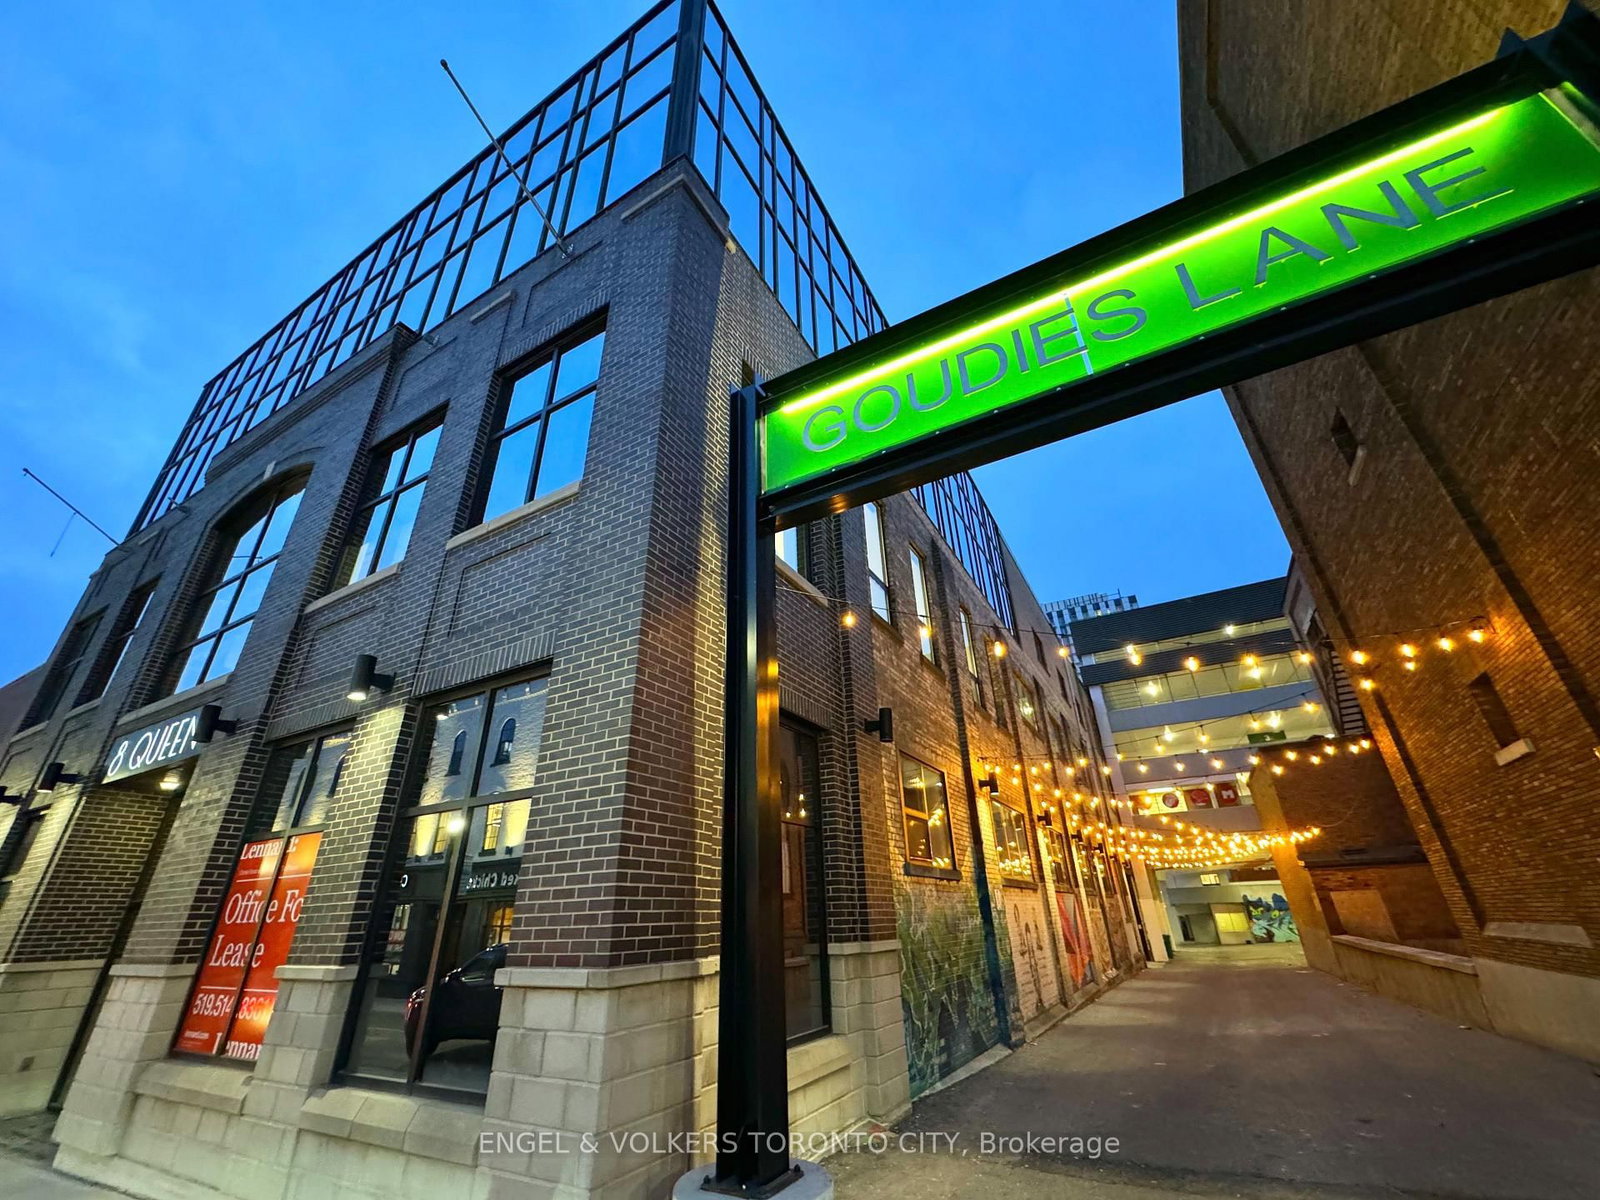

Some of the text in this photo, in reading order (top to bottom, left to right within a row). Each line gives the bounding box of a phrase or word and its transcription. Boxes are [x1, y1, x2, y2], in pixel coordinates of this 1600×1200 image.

[802, 146, 1514, 453] GOUDIES LANE
[107, 715, 198, 777] 8 QUEEN
[224, 889, 279, 925] Office
